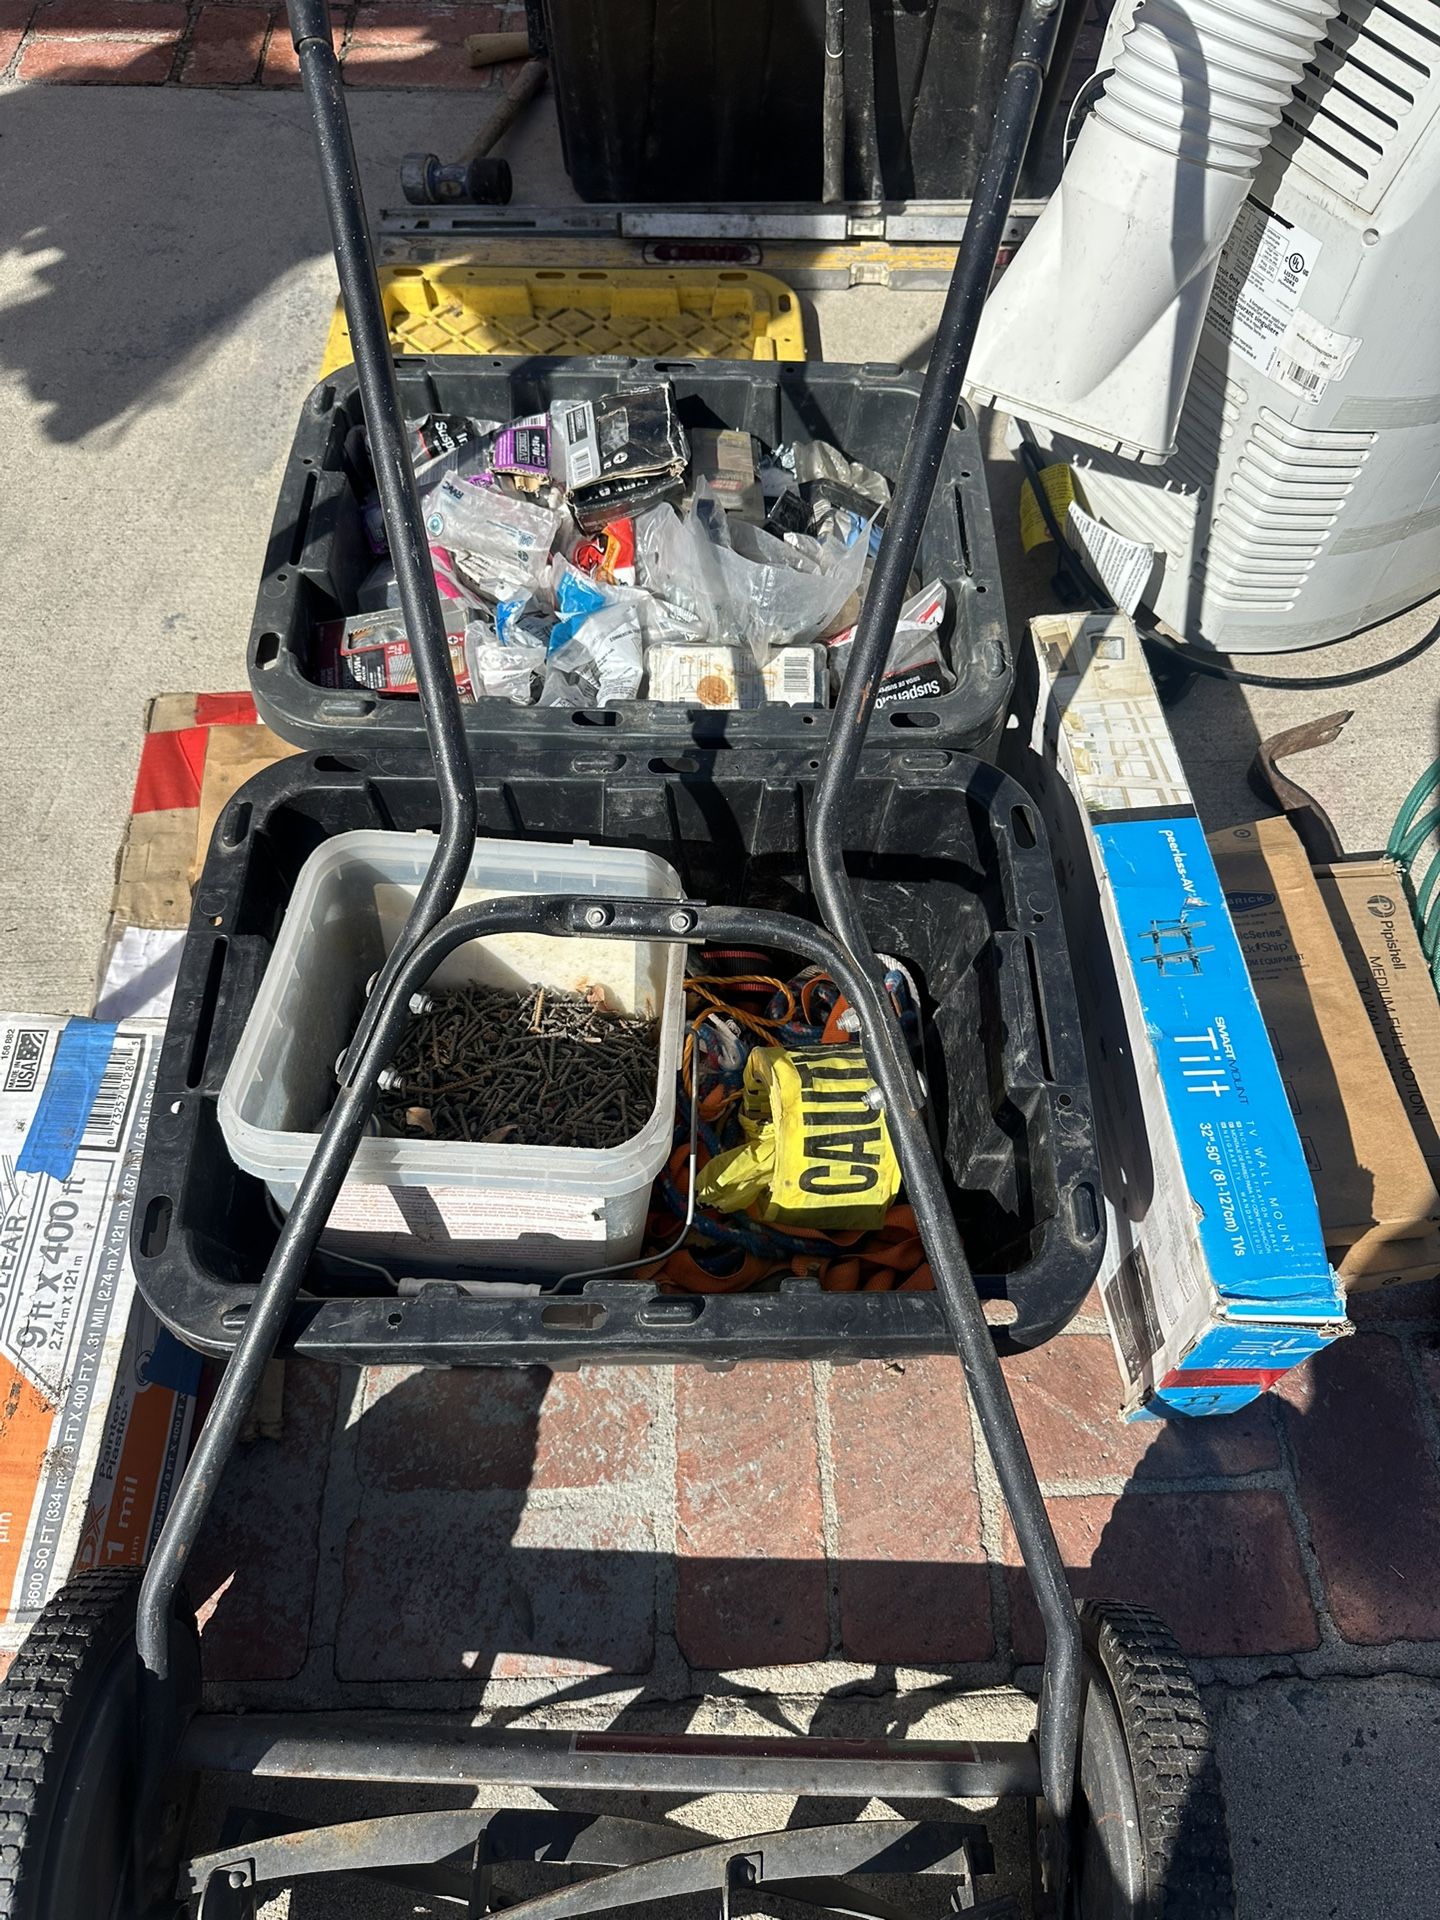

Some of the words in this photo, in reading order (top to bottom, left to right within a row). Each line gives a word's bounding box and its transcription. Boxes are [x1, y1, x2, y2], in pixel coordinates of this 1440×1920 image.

[1283, 268, 1300, 283] LISTED
[1381, 920, 1407, 970] Pipishell
[1368, 956, 1398, 1012] MEDIUM
[1389, 1012, 1407, 1050] FULL
[1400, 1056, 1428, 1117] MOTION
[15, 1062, 37, 1088] USA
[1174, 1026, 1230, 1098] Tilt
[8, 1068, 20, 1088] MADE
[1254, 1147, 1272, 1186] WALL
[1269, 1197, 1294, 1252] MOUNT
[39, 1200, 80, 1265] 400
[112, 1226, 126, 1245] 121
[1230, 1235, 1246, 1256] TVs
[0, 1215, 28, 1309] LEAR
[97, 1274, 115, 1302] (2.74
[31, 1300, 56, 1320] ft
[50, 1320, 68, 1350] 2.74
[64, 1269, 80, 1292] 121
[90, 1304, 108, 1328] MIL
[16, 1326, 48, 1348] 9
[78, 1364, 94, 1383] FT
[74, 1384, 90, 1413] 400
[64, 1426, 80, 1444] FT
[44, 1492, 64, 1522] (334
[107, 1540, 125, 1560] 1
[118, 1476, 138, 1529] mil
[39, 1526, 56, 1544] FT
[34, 1548, 51, 1571] SQ
